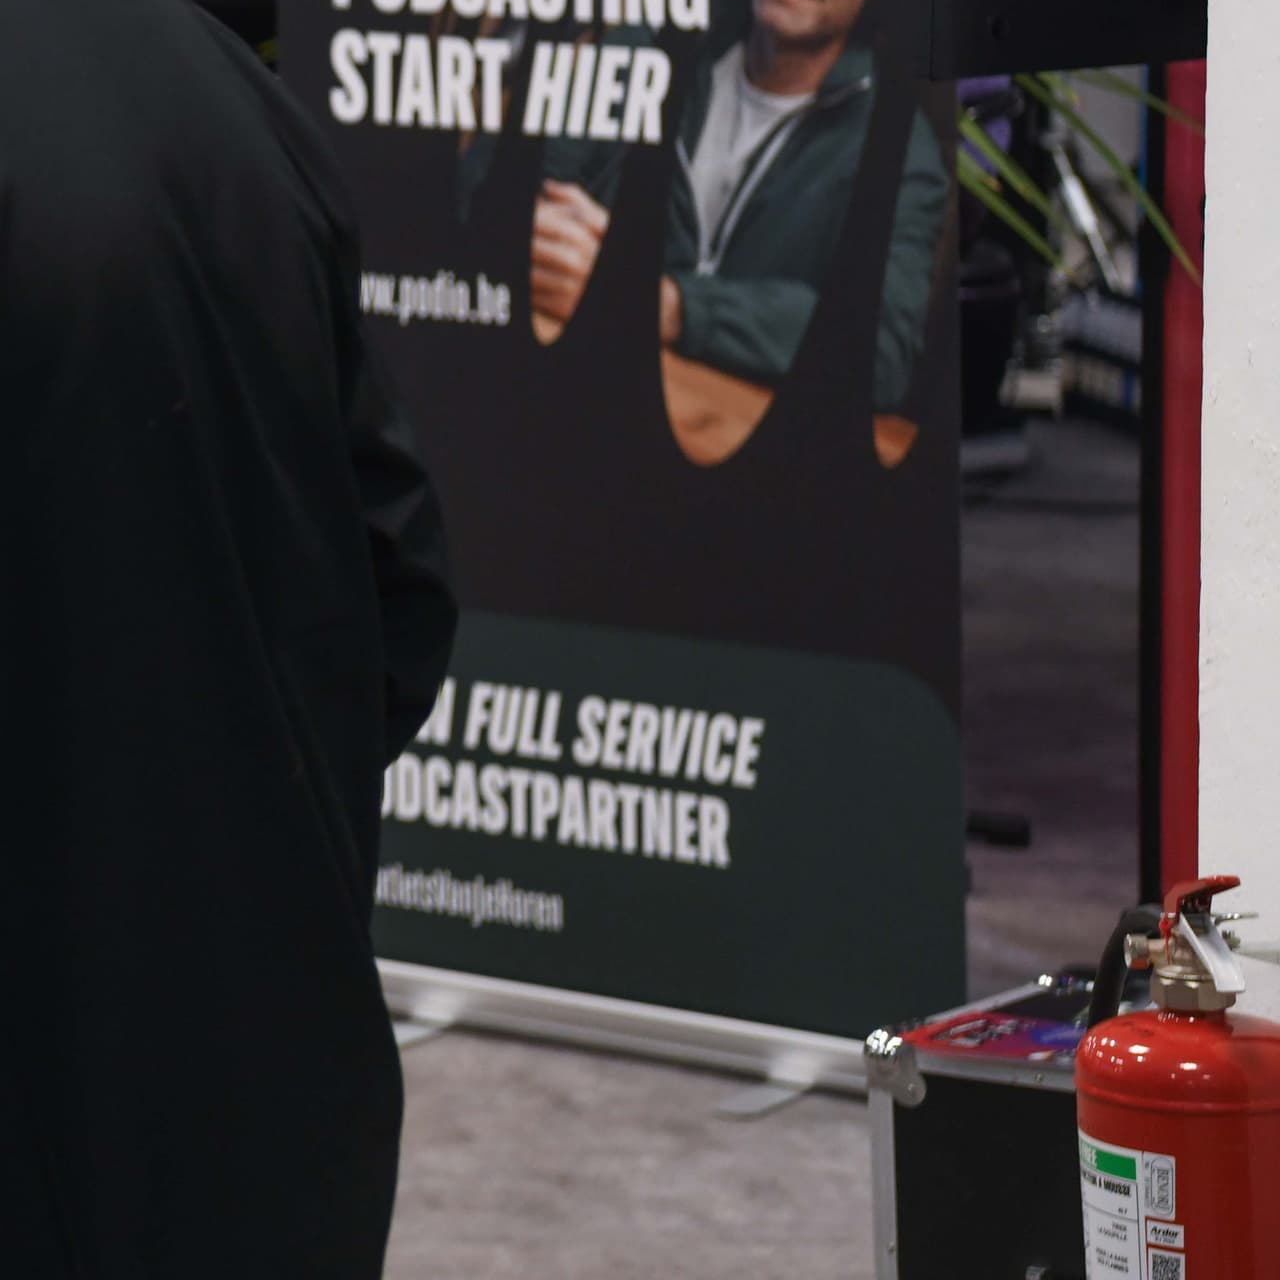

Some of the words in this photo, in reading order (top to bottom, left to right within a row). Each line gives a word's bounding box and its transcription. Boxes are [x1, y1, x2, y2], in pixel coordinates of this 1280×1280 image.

[328, 28, 512, 132] START
[522, 40, 672, 144] HIER
[360, 268, 511, 327] ww.podio.be
[464, 680, 563, 762] FULL
[571, 693, 765, 790] SERVICE
[380, 751, 732, 869] DCASTPARTNER
